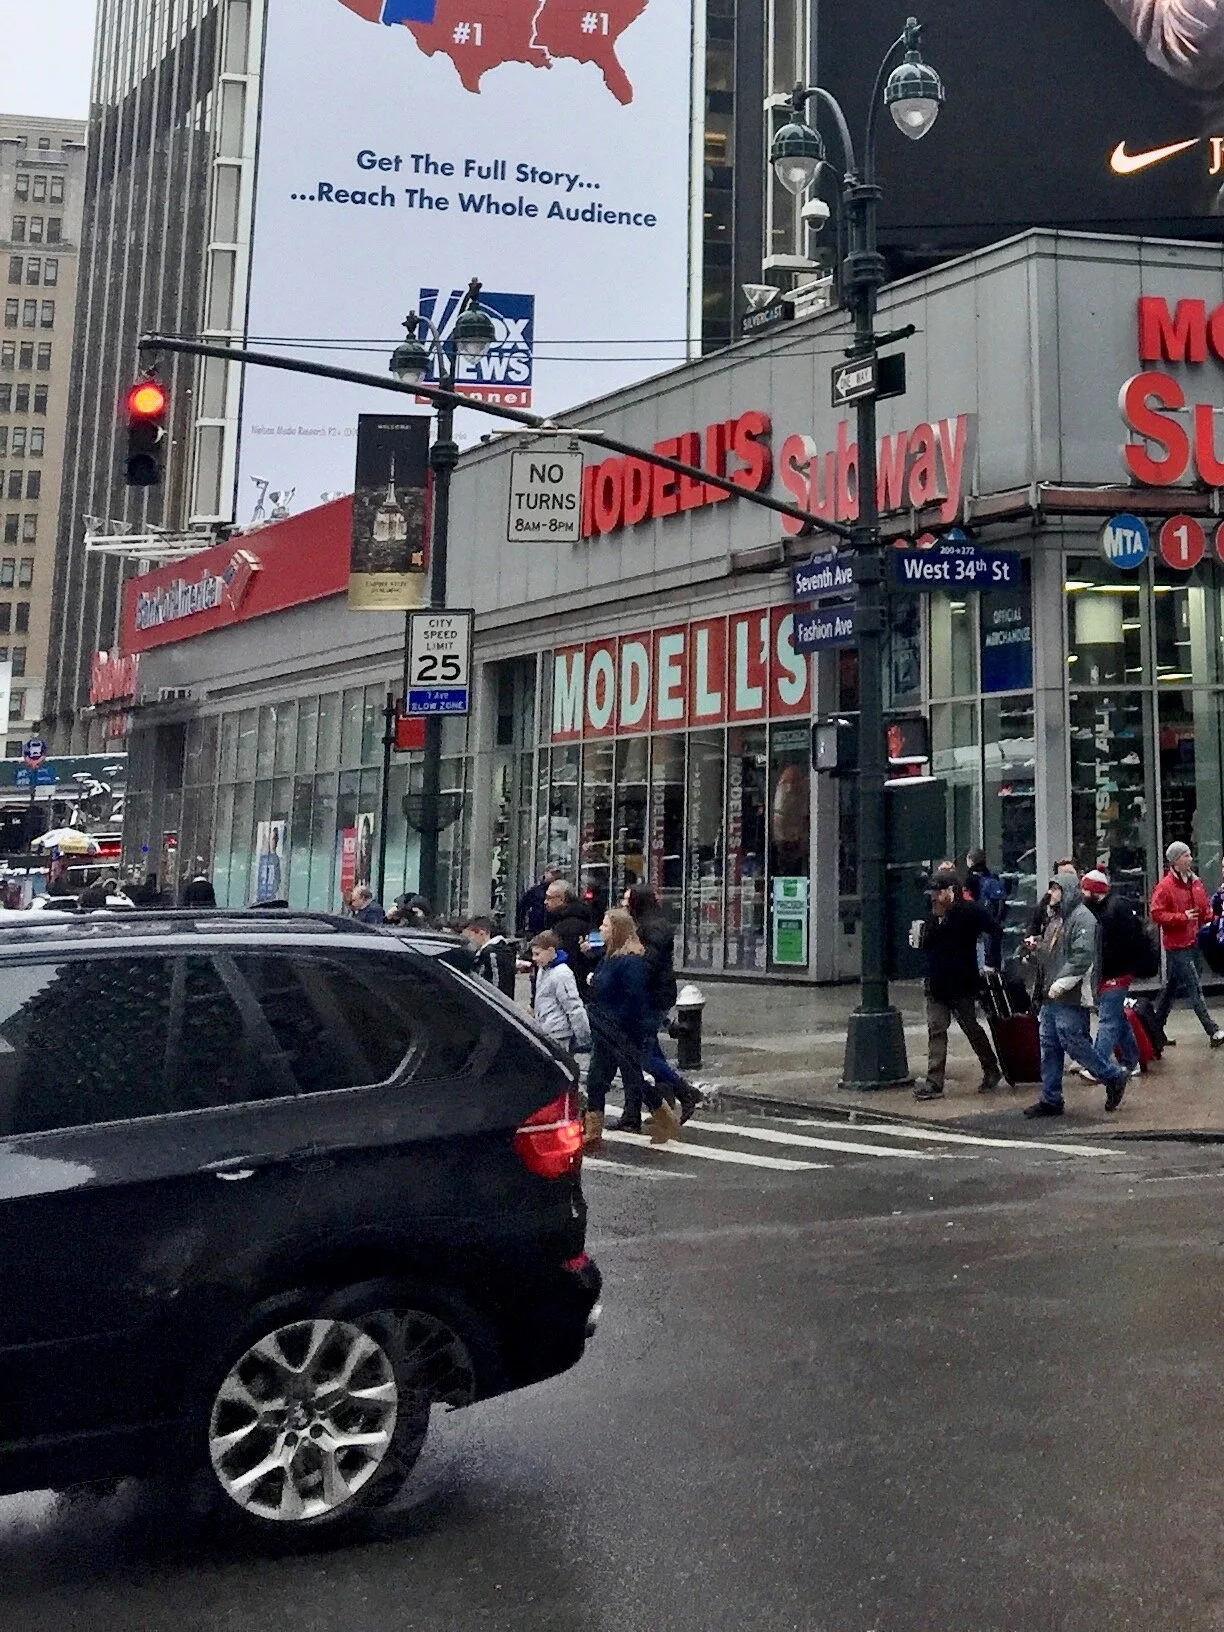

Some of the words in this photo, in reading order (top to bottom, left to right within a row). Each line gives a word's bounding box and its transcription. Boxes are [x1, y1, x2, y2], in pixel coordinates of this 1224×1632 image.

[453, 22, 482, 46] #1
[580, 11, 609, 36] #1
[356, 149, 403, 172] Get
[411, 154, 455, 177] The
[464, 159, 506, 181] Full
[515, 164, 601, 193] Story...
[290, 182, 396, 208] ...Reach
[405, 188, 450, 212] The
[458, 193, 539, 218] Whole
[546, 201, 658, 228] Audience
[529, 463, 564, 484] NO
[779, 413, 976, 536] Subway
[514, 492, 576, 510] TURNS
[514, 517, 574, 532] 8AM-8PM
[1103, 528, 1144, 559] MTA
[1174, 528, 1188, 561] 1
[796, 565, 832, 594] Seventh
[834, 566, 852, 585] Ave
[904, 558, 950, 581] West
[954, 558, 988, 581] 34th
[992, 561, 1010, 581] St
[423, 630, 458, 639] SPEED
[429, 619, 452, 628] CITY
[798, 620, 833, 642] Fashion
[834, 618, 853, 636] Ave
[427, 641, 454, 651] LIMIT
[417, 654, 461, 681] 25
[553, 613, 807, 735] MODELL'S
